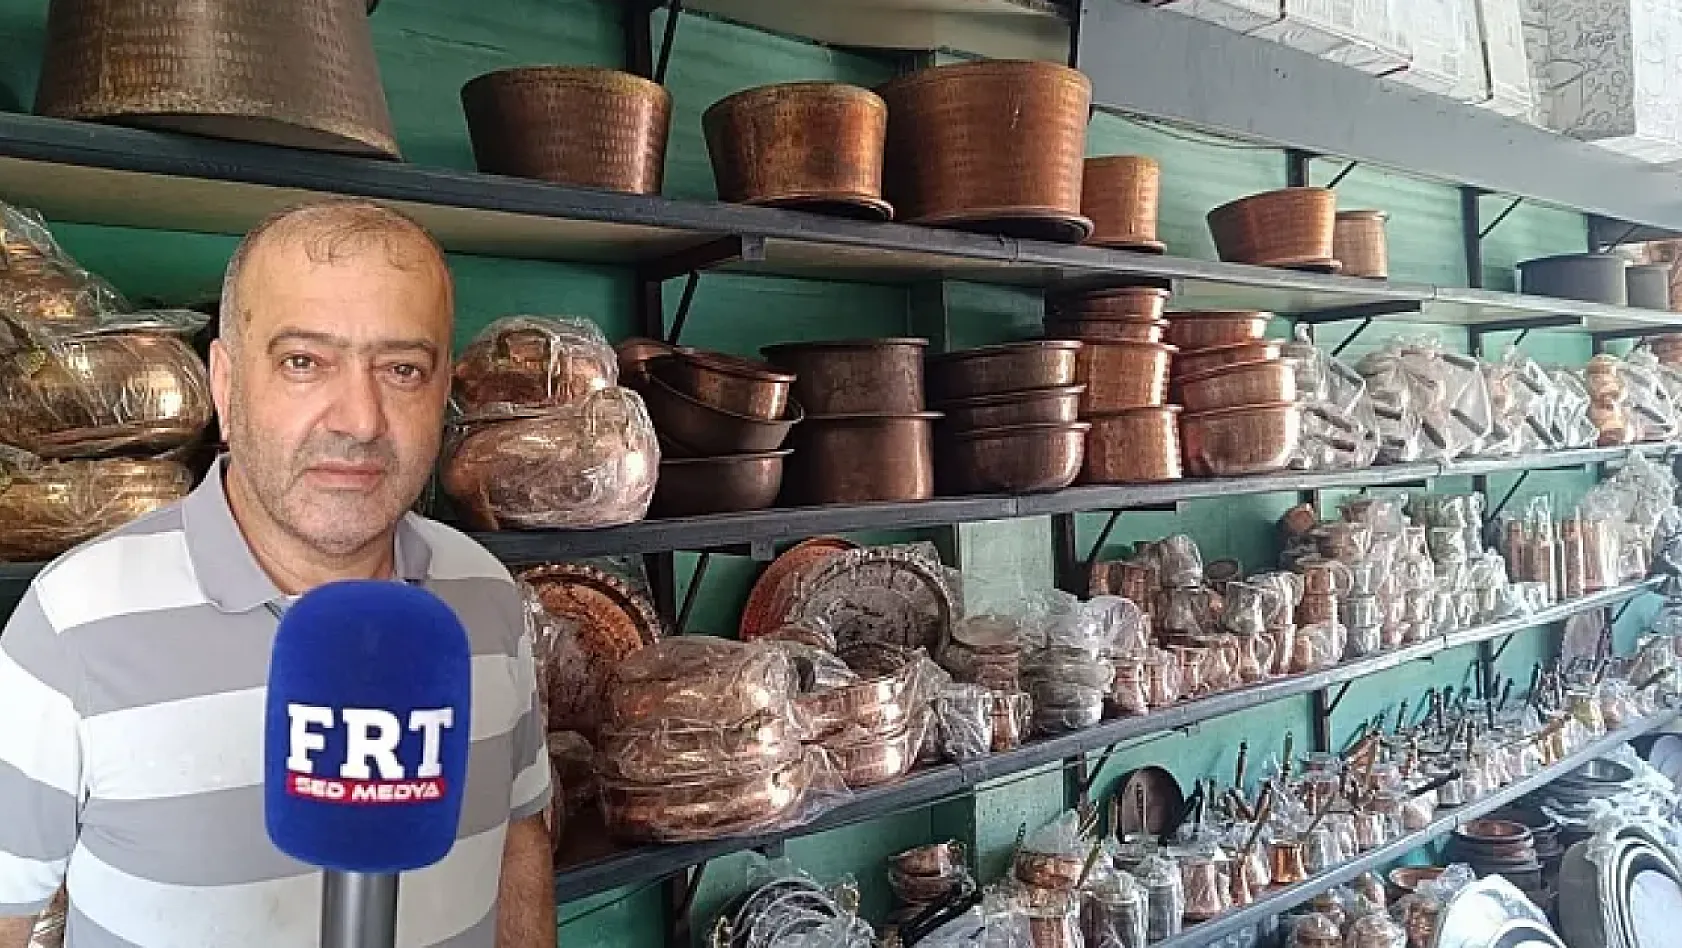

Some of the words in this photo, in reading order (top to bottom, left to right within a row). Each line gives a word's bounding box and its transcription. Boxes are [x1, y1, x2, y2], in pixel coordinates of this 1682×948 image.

[287, 703, 454, 779] FRT
[295, 777, 345, 799] SED
[351, 782, 441, 801] MEDYA
